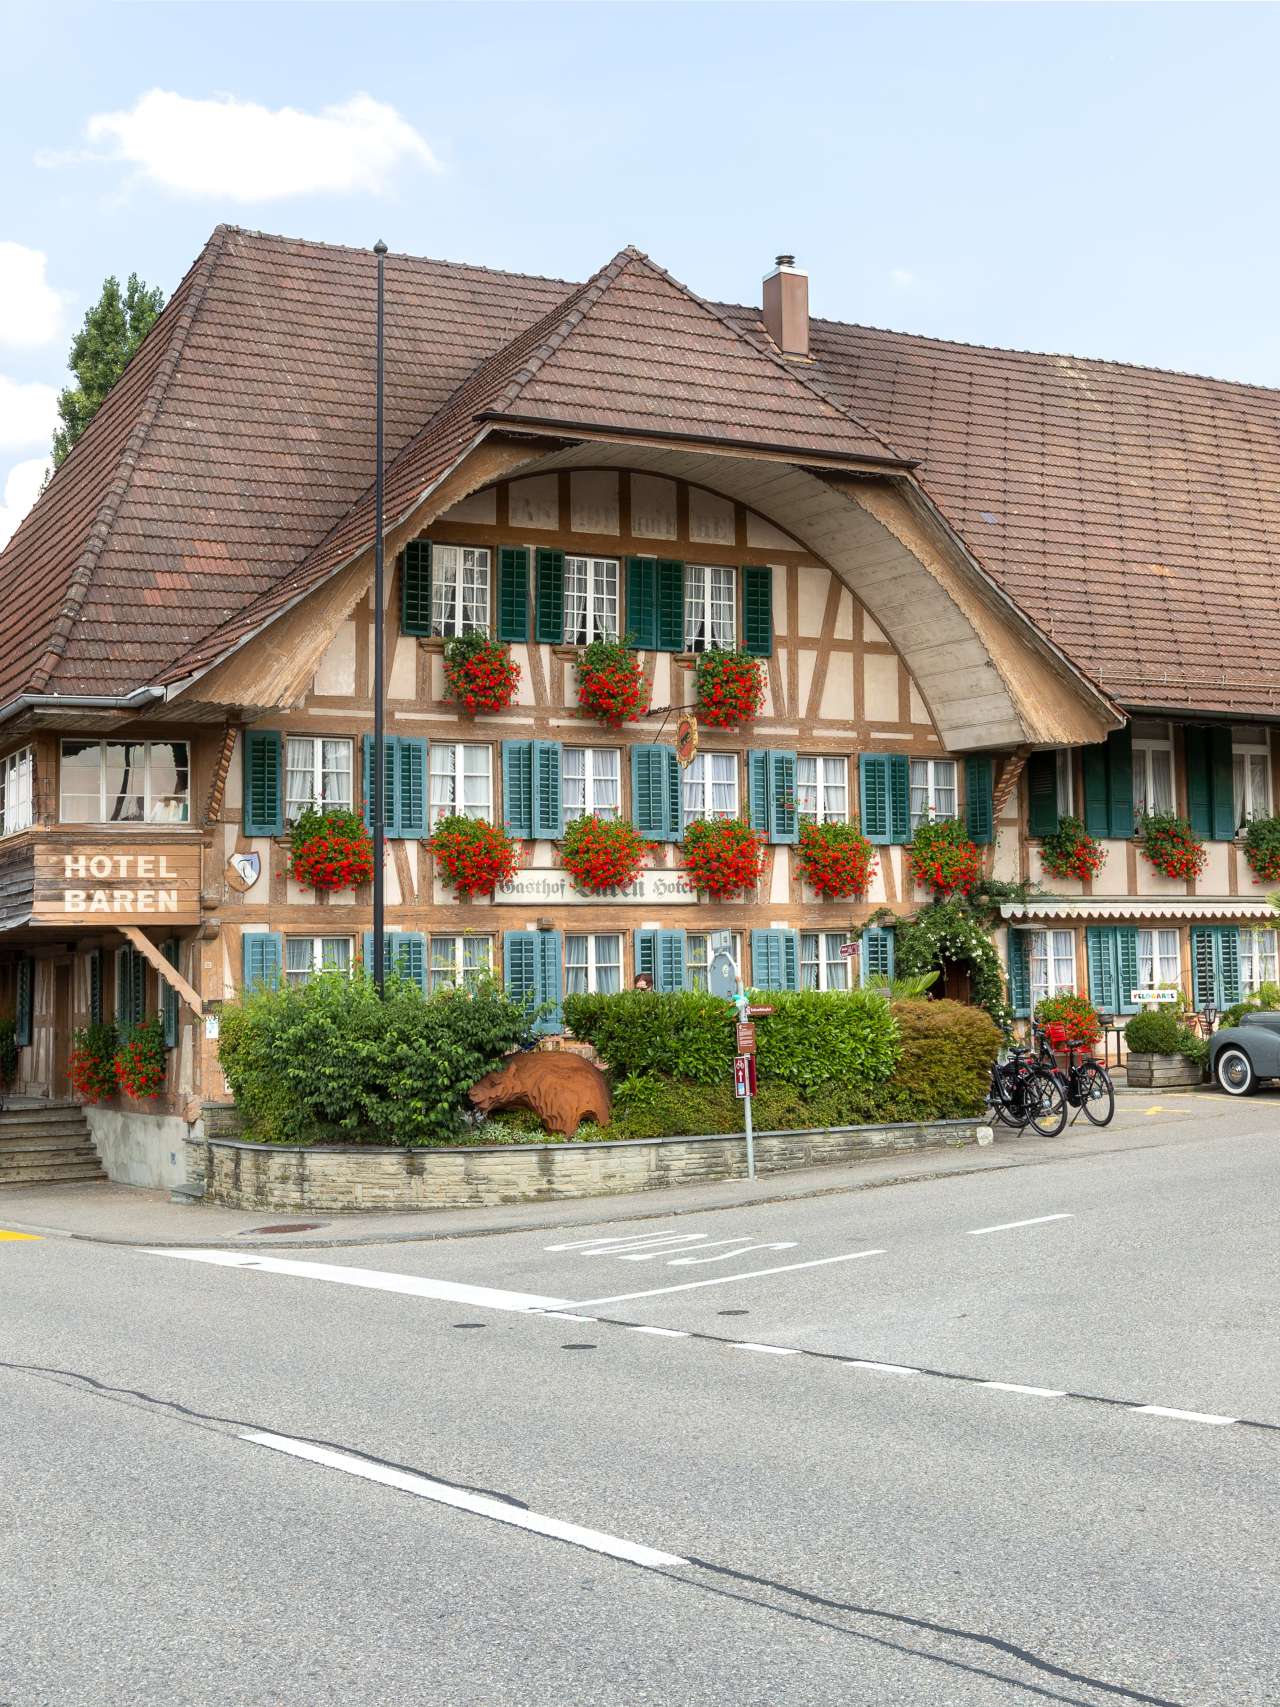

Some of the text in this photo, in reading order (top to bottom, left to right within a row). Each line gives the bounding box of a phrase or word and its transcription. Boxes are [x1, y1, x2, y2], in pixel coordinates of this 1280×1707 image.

[64, 855, 177, 878] HOTEL
[498, 877, 566, 898] Gasthof
[64, 889, 178, 912] BÄREN
